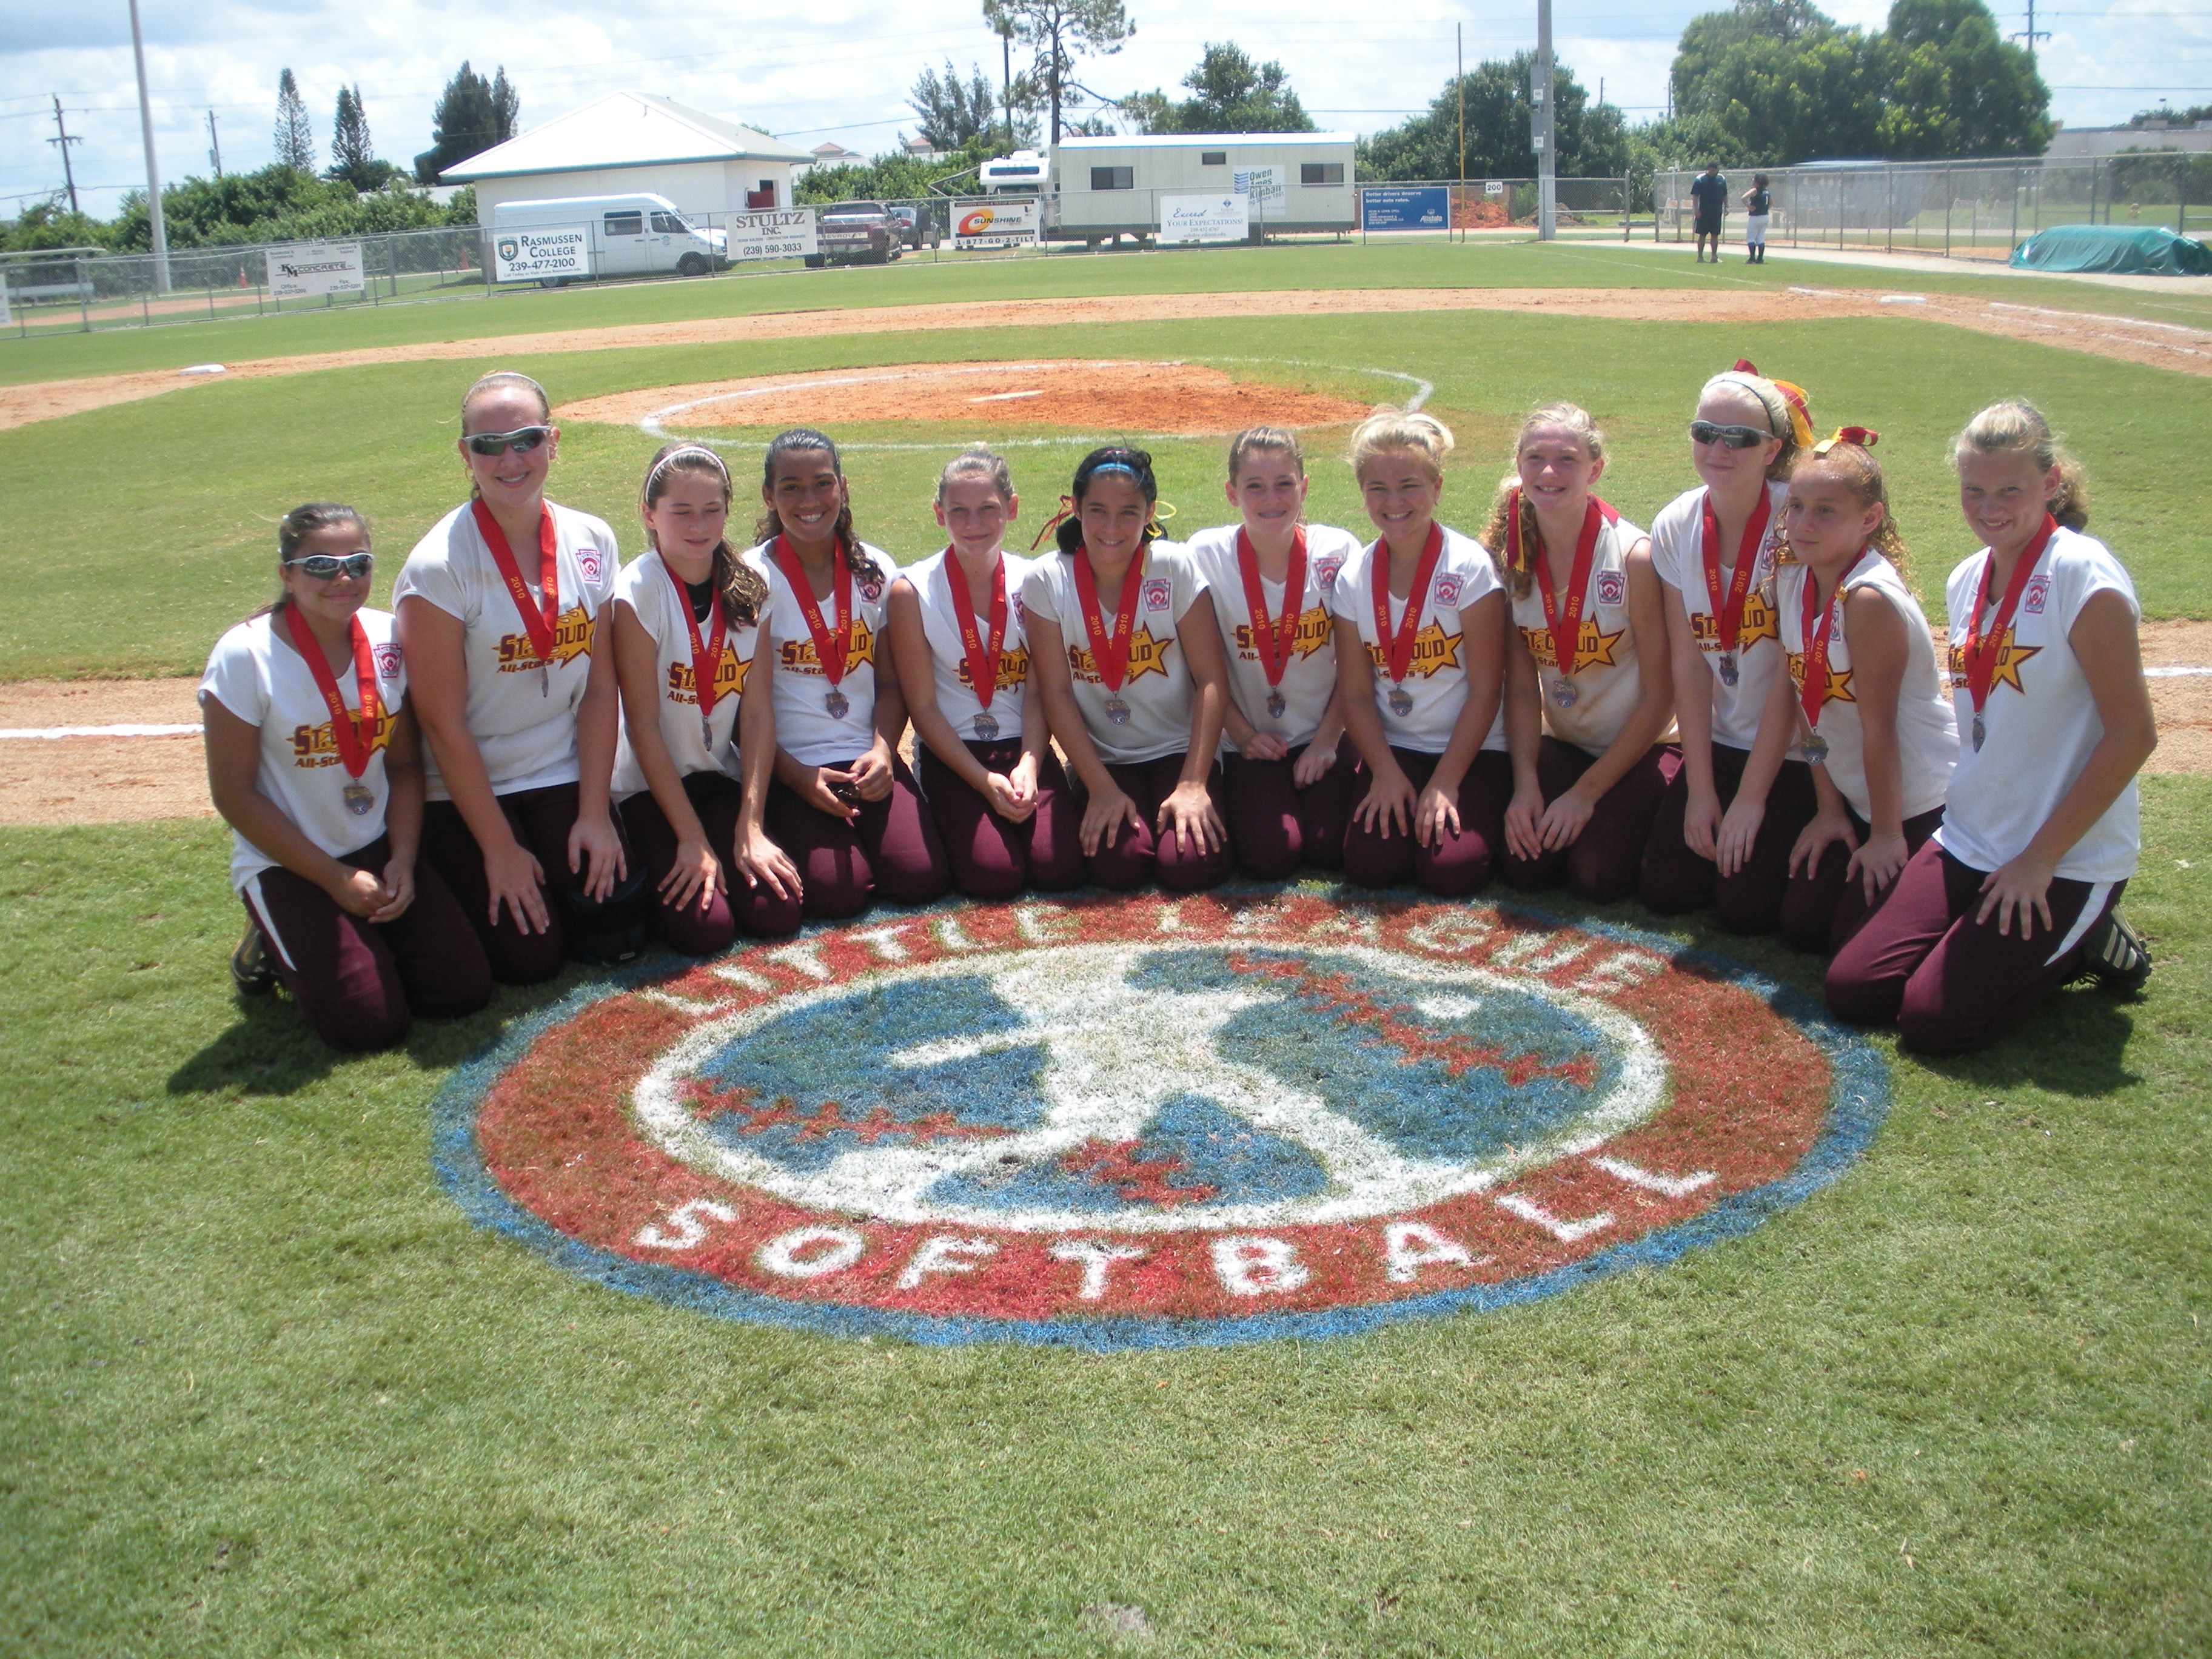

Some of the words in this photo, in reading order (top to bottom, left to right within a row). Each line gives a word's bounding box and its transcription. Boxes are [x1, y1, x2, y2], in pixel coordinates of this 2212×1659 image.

[1250, 169, 1272, 181] Owen
[1249, 183, 1281, 199] Kimball
[736, 212, 805, 229] STULTZ
[762, 227, 781, 235] INC.
[521, 234, 582, 247] RASMUSSEN
[743, 246, 762, 256] (239)
[765, 243, 802, 253] 590-3033
[957, 236, 1034, 245] 1-877-GO-2-TILT
[530, 246, 576, 258] COLLEGE
[298, 263, 346, 272] CONCRETE
[509, 258, 575, 272] 239-477-2100
[511, 577, 526, 599] 2010
[1709, 569, 1718, 591] 2010
[1734, 571, 1747, 593] 2010
[1378, 605, 1388, 626] 2010
[1569, 596, 1580, 618] 2010
[808, 608, 822, 629] 2010
[1091, 615, 1102, 635] 2010
[1118, 614, 1128, 635] 2010
[1255, 609, 1266, 630] 2010
[1284, 613, 1295, 634] 2010
[1405, 607, 1417, 629] 2010
[499, 634, 529, 663] ST.
[554, 623, 586, 647] OUD
[711, 637, 720, 658] 2010
[965, 628, 977, 649] 2010
[782, 640, 810, 665] ST.
[1412, 639, 1445, 660] OUD
[1814, 640, 1824, 665] 2010
[328, 691, 343, 715] 2010
[364, 694, 374, 718] 2010
[638, 905, 1082, 1016] LITTLE
[634, 1155, 1717, 1299] SOFTBALL
